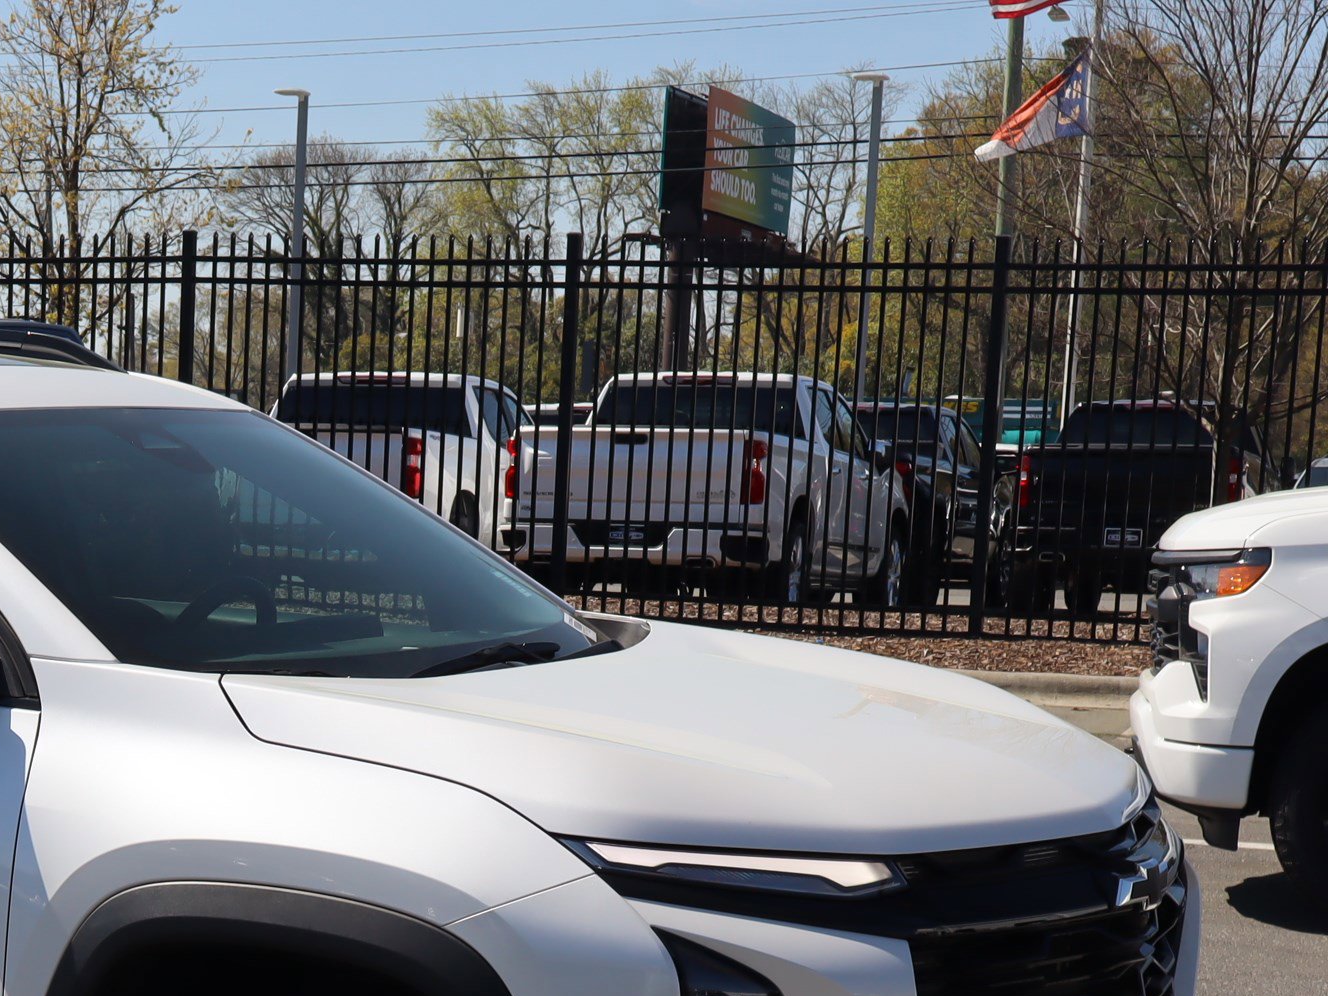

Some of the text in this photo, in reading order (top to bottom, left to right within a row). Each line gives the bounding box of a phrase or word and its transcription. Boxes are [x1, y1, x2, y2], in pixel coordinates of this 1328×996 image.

[715, 107, 730, 134] LIFE
[714, 137, 733, 167] YOUR
[734, 149, 749, 172] CAR
[711, 169, 740, 198] SHOULD
